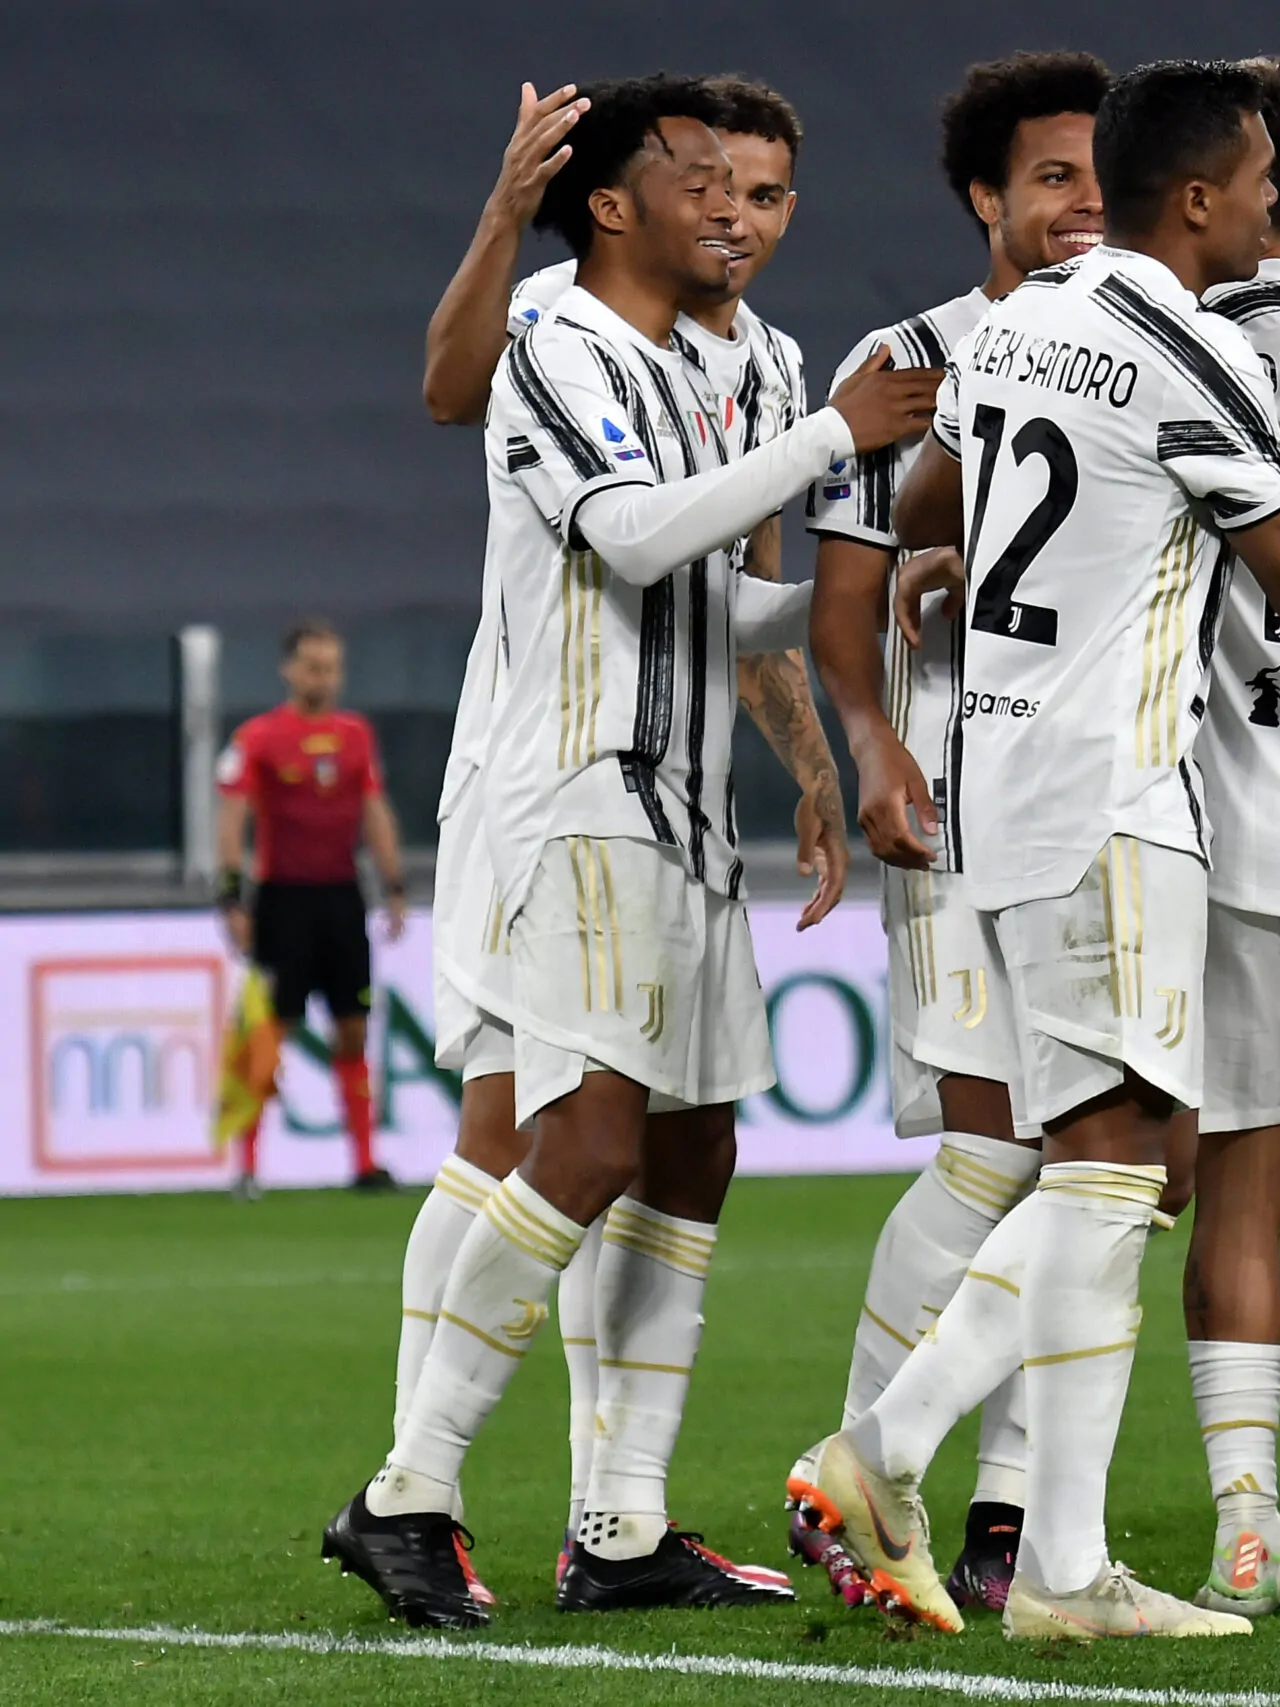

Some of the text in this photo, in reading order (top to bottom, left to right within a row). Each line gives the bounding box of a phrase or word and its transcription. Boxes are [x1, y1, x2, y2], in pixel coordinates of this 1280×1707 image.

[968, 325, 1138, 409] ALEX SANDRO
[971, 402, 1079, 648] 12
